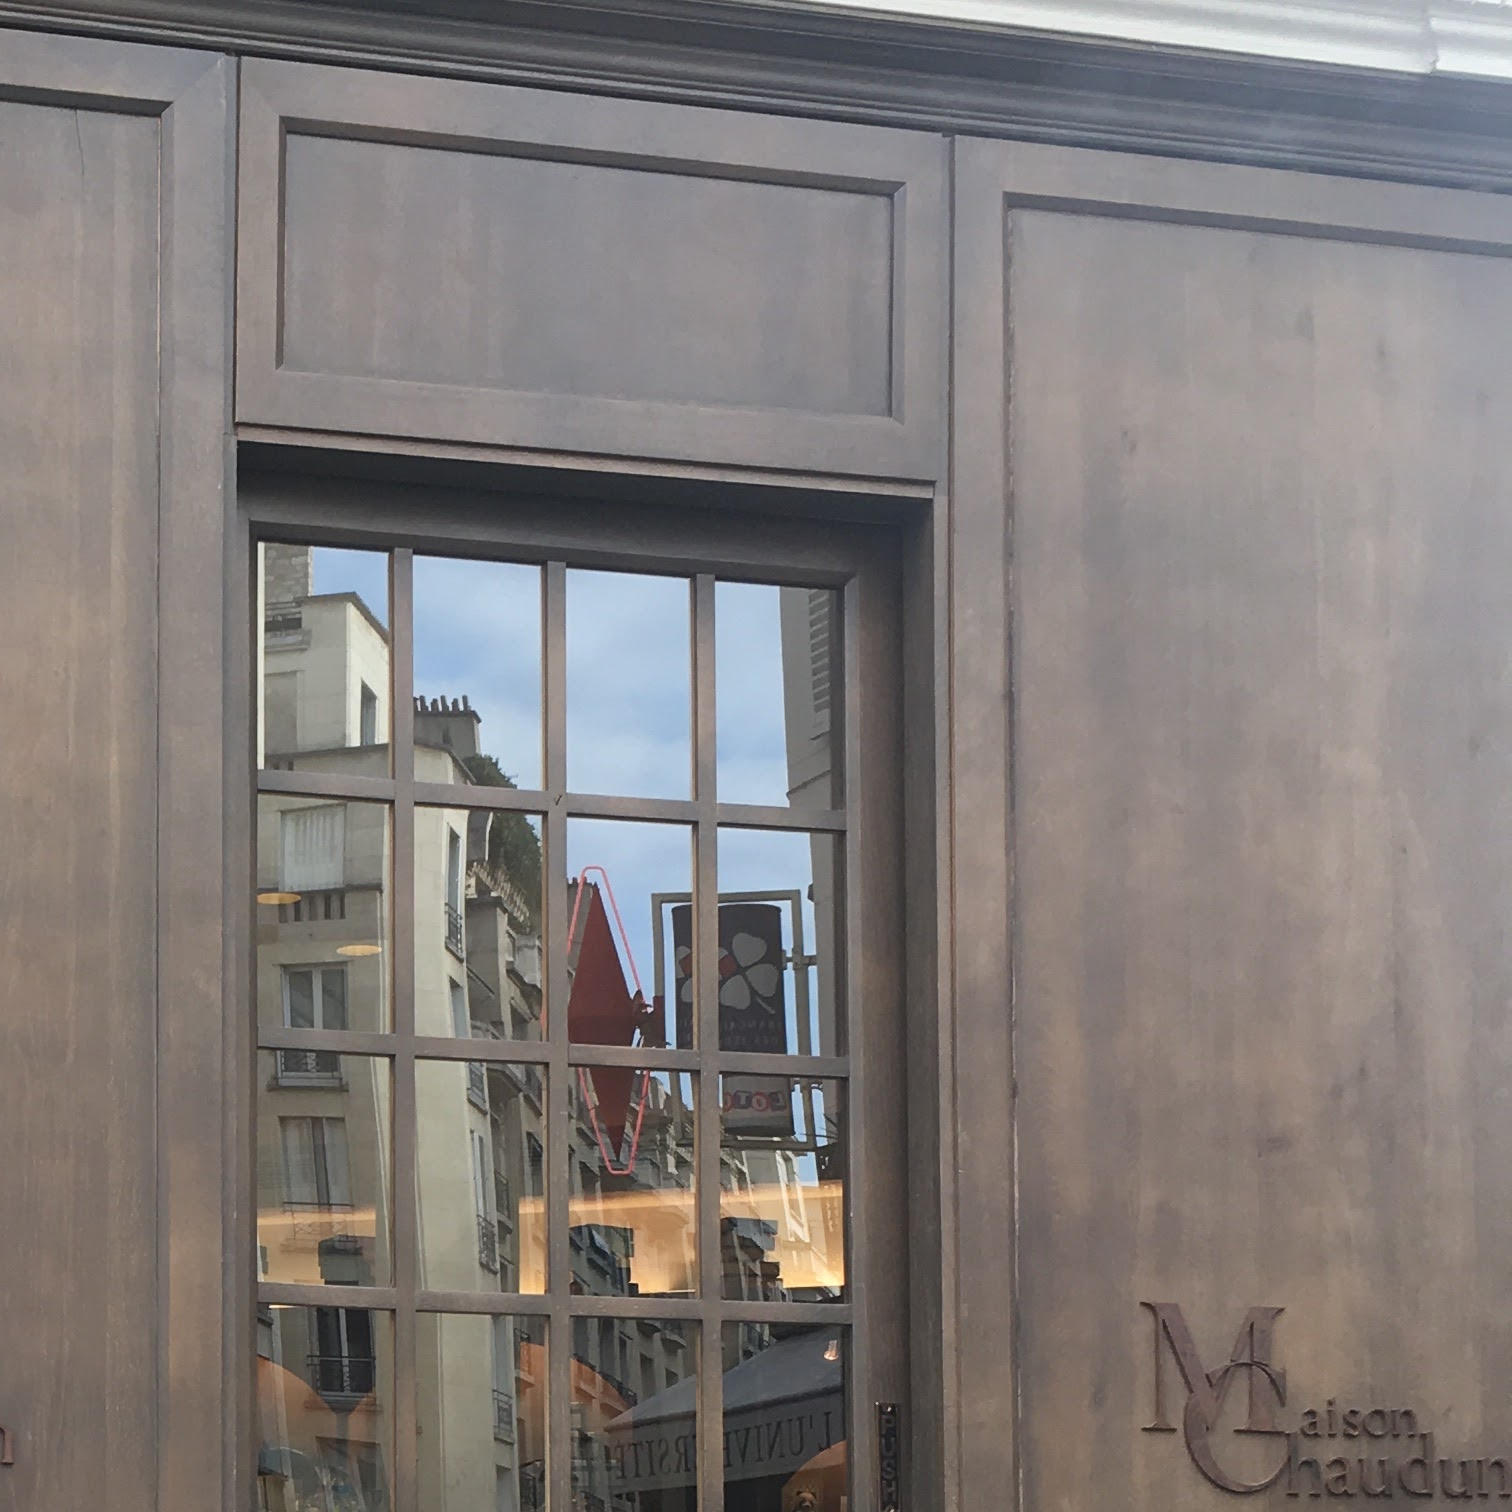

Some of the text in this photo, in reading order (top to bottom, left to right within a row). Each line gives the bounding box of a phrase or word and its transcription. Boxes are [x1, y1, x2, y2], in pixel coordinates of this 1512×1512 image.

[1139, 1301, 1419, 1438] Maison
[1183, 1361, 1512, 1499] Chaudun
[881, 1414, 897, 1504] PUSH
